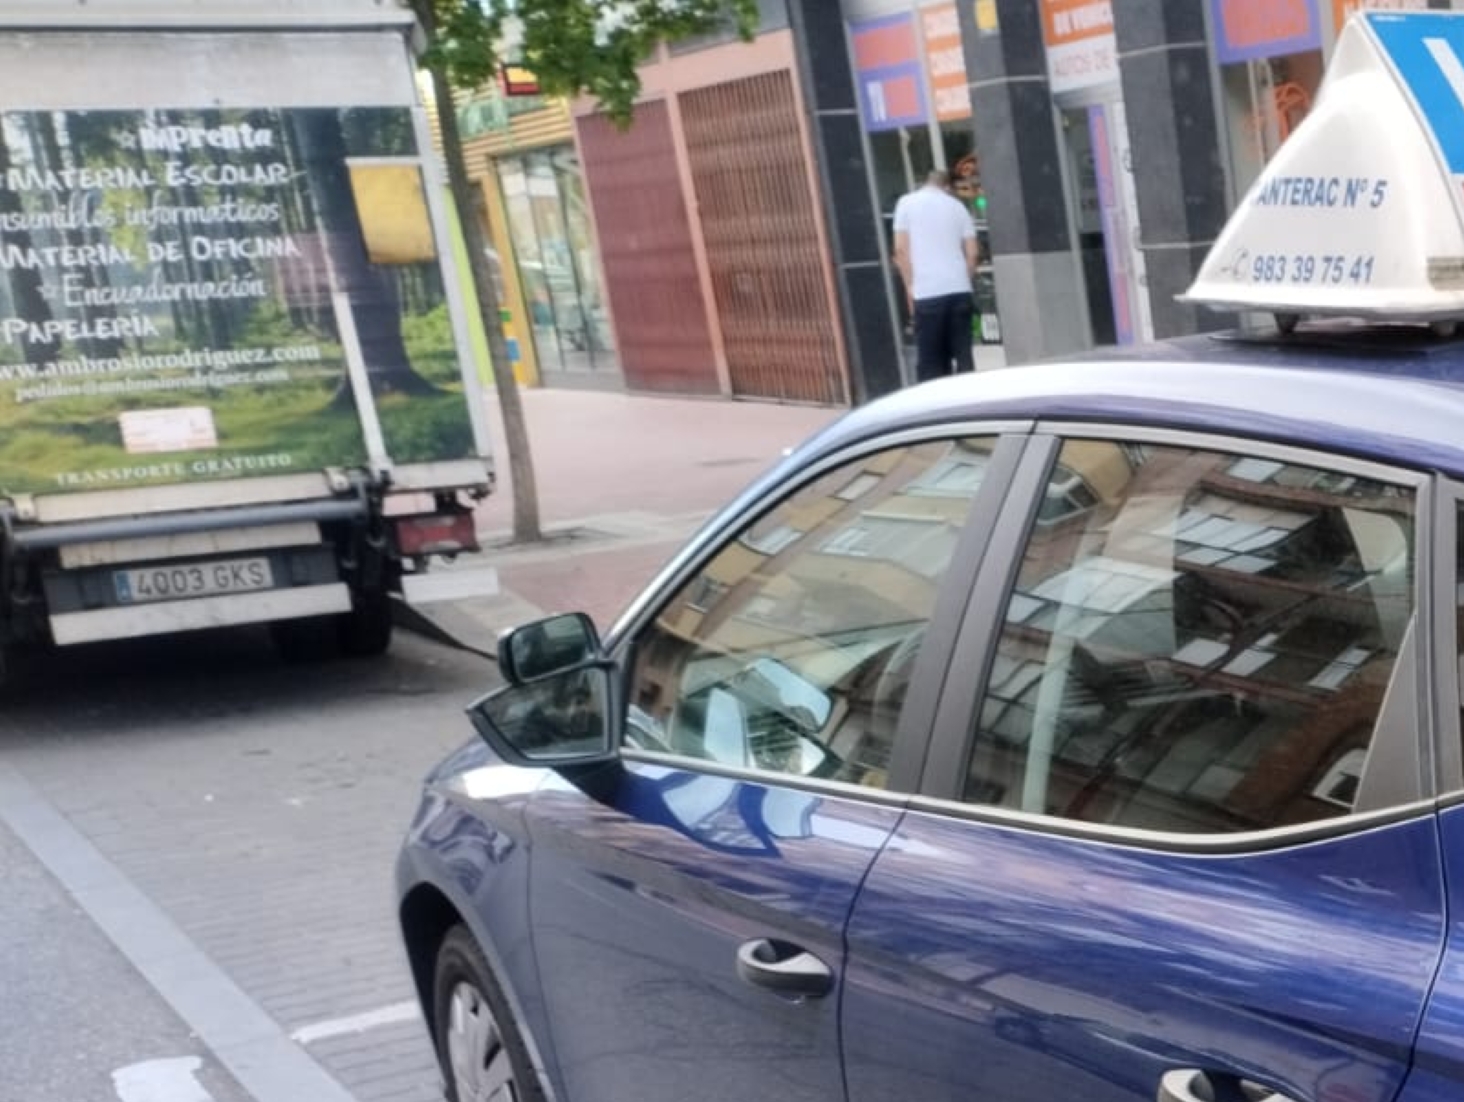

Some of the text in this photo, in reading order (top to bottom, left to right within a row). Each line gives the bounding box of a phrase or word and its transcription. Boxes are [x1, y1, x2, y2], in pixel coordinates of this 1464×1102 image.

[6, 160, 291, 191] MATERIAL ESCOLAR
[1370, 180, 1388, 210] 5
[0, 235, 302, 270] MATERIAL DE OFICINA
[1252, 256, 1375, 285] 983 39 75 41
[57, 453, 292, 486] TRANSPORTE GRATUITO
[137, 561, 264, 595] 4003 GKS
